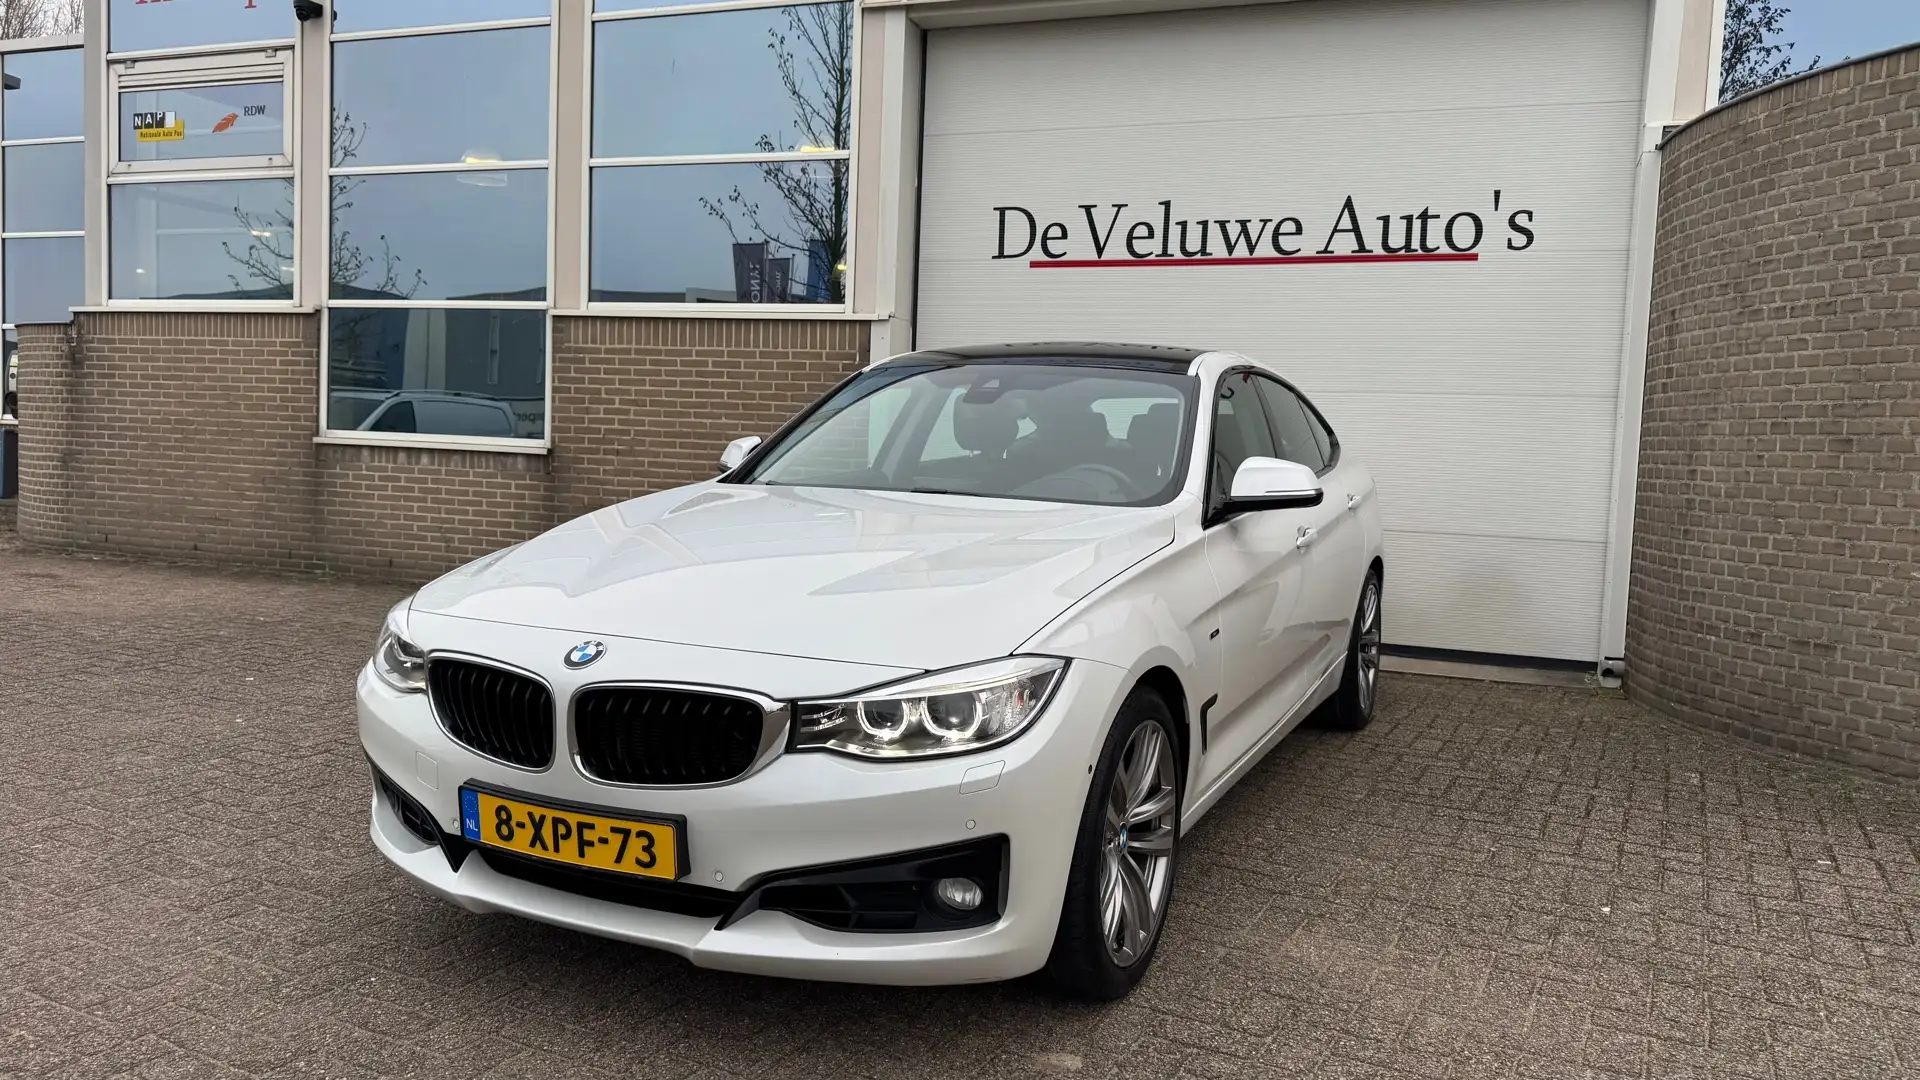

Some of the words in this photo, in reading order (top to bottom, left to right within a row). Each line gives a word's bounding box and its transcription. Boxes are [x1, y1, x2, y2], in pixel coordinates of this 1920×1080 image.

[133, 111, 165, 128] NAP
[243, 105, 266, 117] RDW
[991, 205, 1069, 260] De
[1078, 200, 1303, 260] Veluwe
[1315, 189, 1535, 255] Auto's
[466, 818, 479, 832] NL
[494, 804, 657, 869] 8-XPF-73
